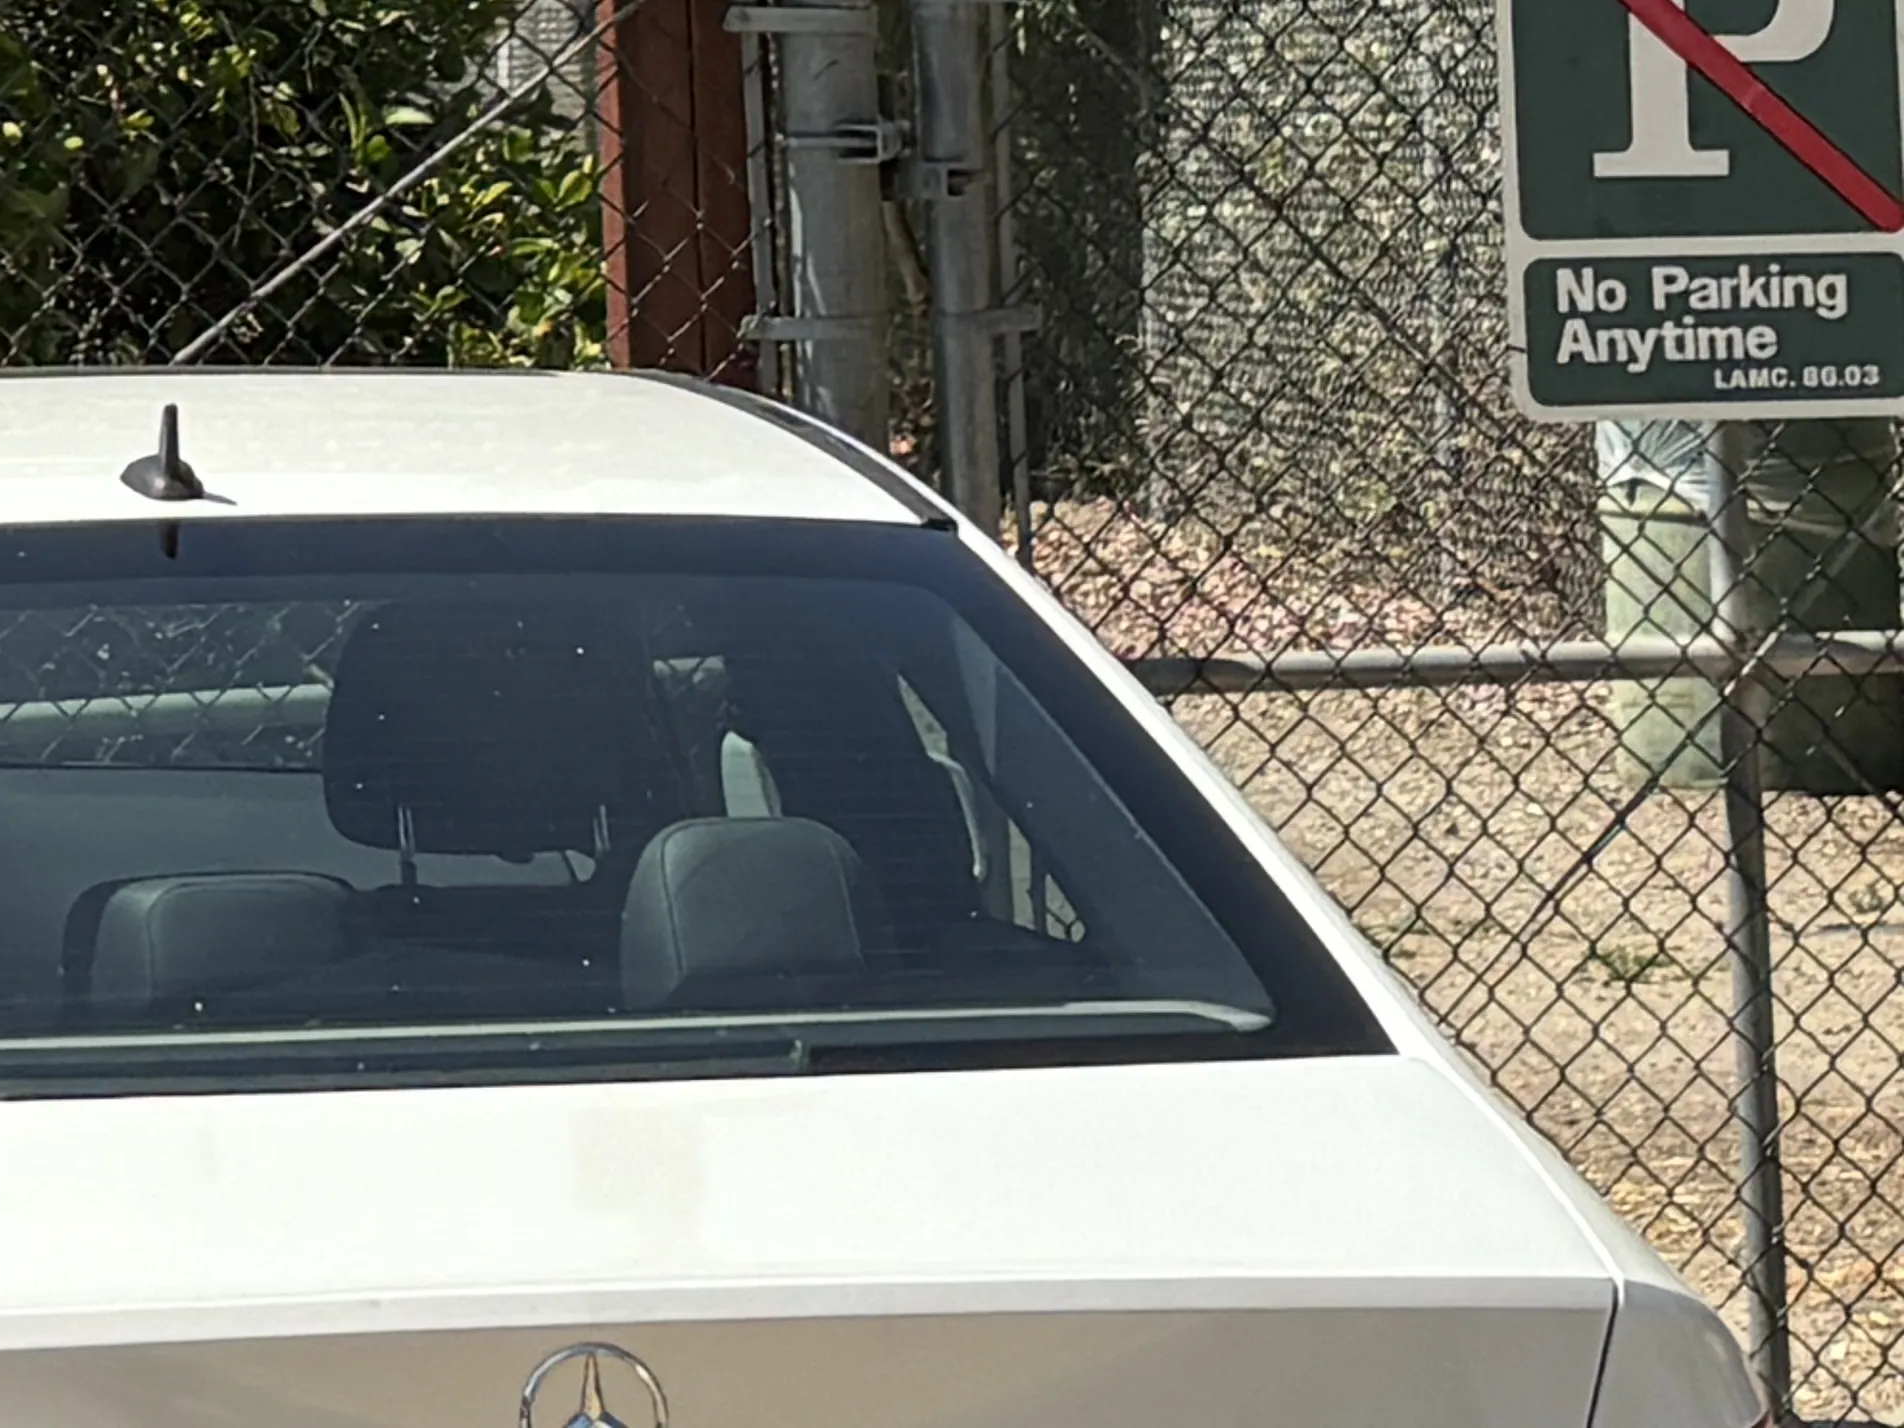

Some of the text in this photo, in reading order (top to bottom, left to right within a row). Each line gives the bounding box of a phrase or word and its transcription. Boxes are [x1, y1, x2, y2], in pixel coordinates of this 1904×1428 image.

[1556, 264, 1848, 319] No Parking
[1557, 318, 1779, 374] Anytime
